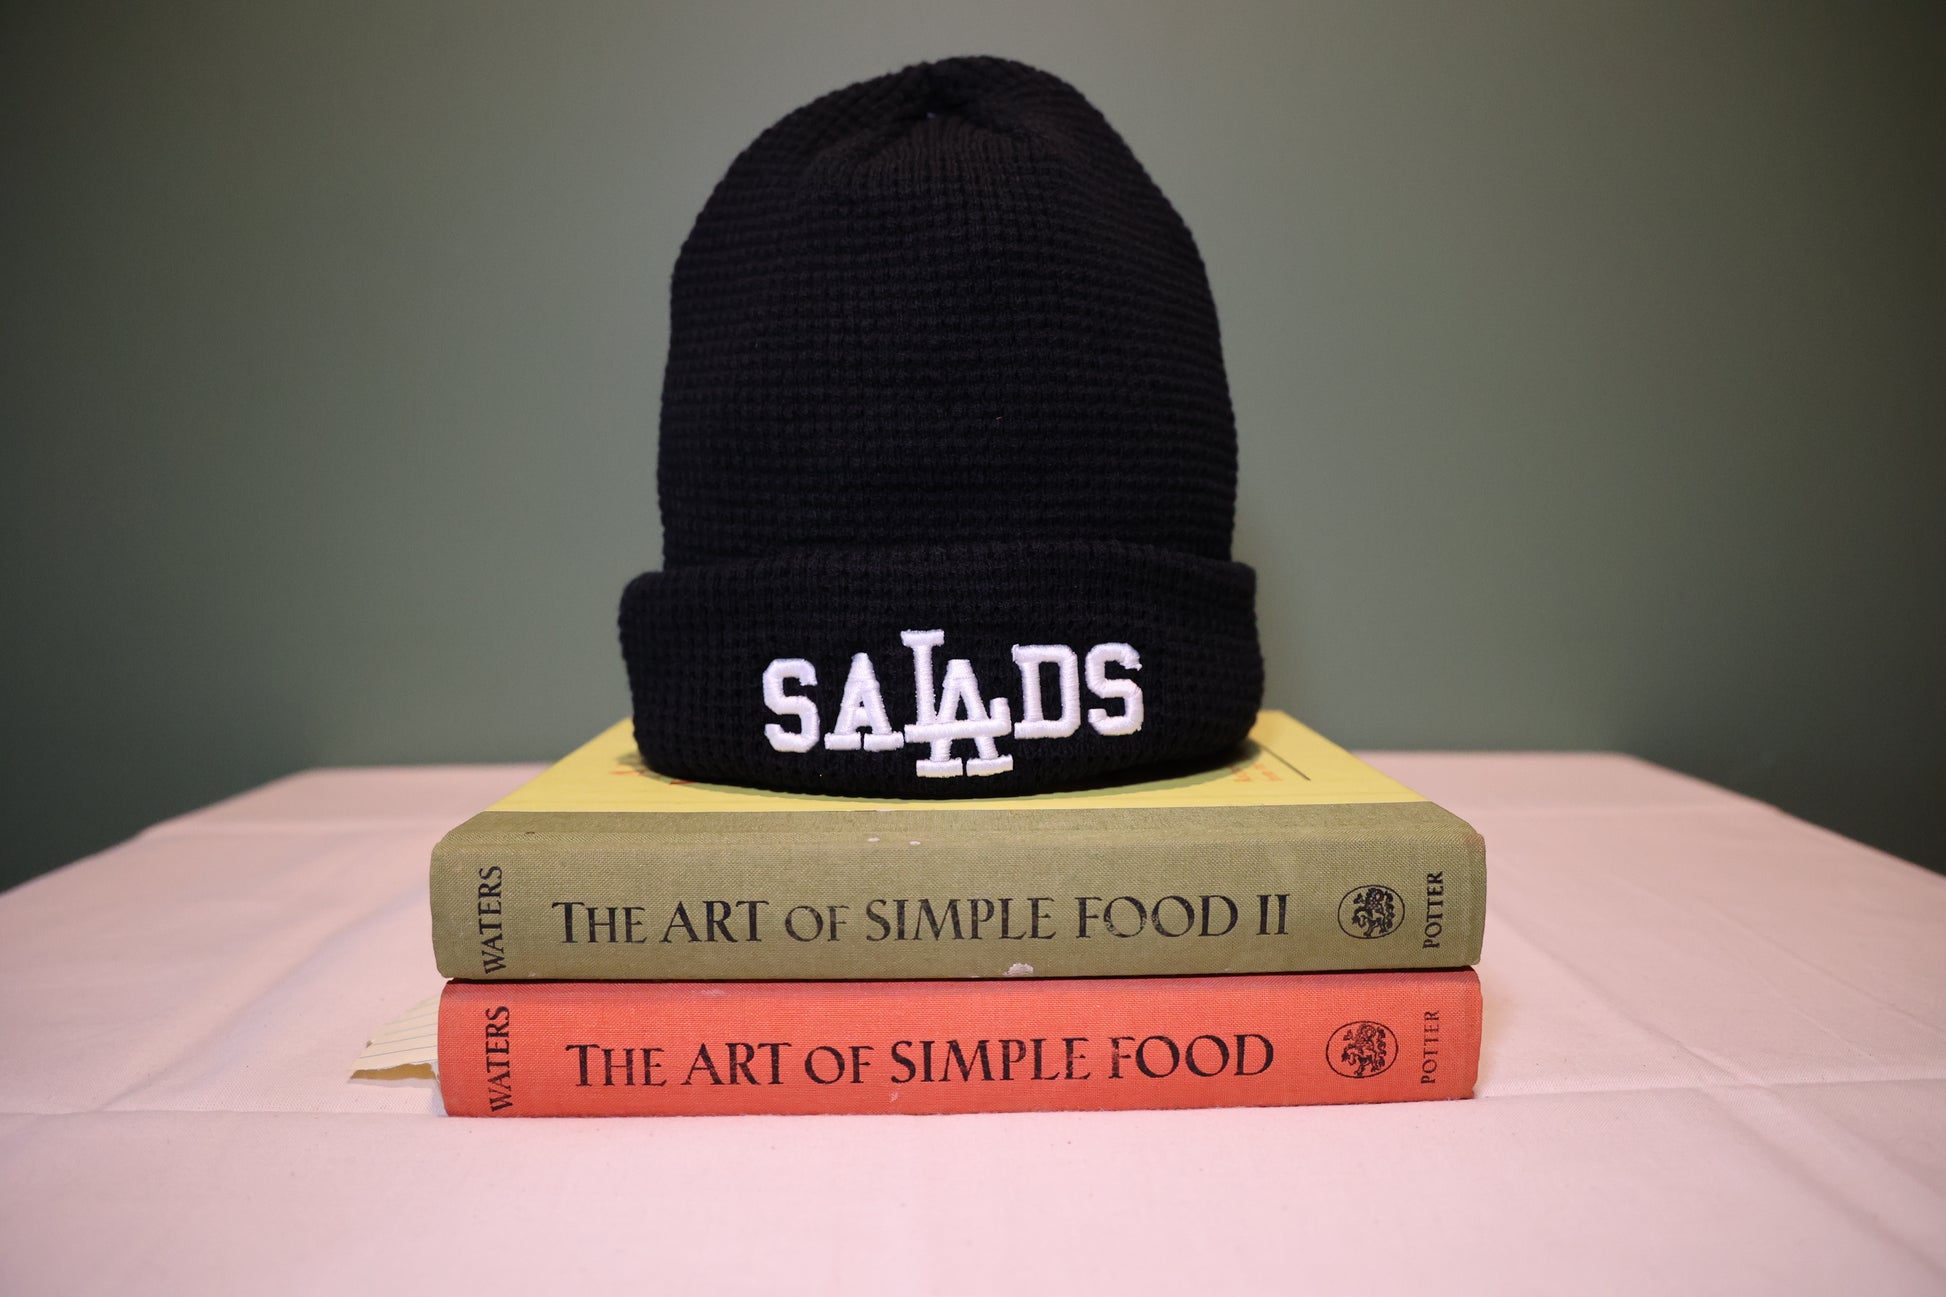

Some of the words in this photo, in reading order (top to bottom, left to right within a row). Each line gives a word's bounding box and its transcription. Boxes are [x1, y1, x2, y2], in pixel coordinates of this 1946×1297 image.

[762, 629, 1144, 778] SALADS
[477, 866, 507, 975] WATERS
[551, 901, 648, 944] THE
[658, 900, 770, 944] ART
[784, 905, 850, 943] OF
[866, 897, 1057, 942] SIMPLE
[1074, 894, 1239, 939] FOOD
[1255, 893, 1290, 936] II
[1422, 871, 1444, 949] POTTER
[485, 1006, 513, 1112] WATERS
[564, 1043, 667, 1087] THE
[680, 1042, 792, 1086] ART
[804, 1045, 874, 1085] OF
[890, 1037, 1091, 1084] SIMPLE
[1108, 1033, 1274, 1080] FOOD
[1420, 1010, 1440, 1084] POTTER
